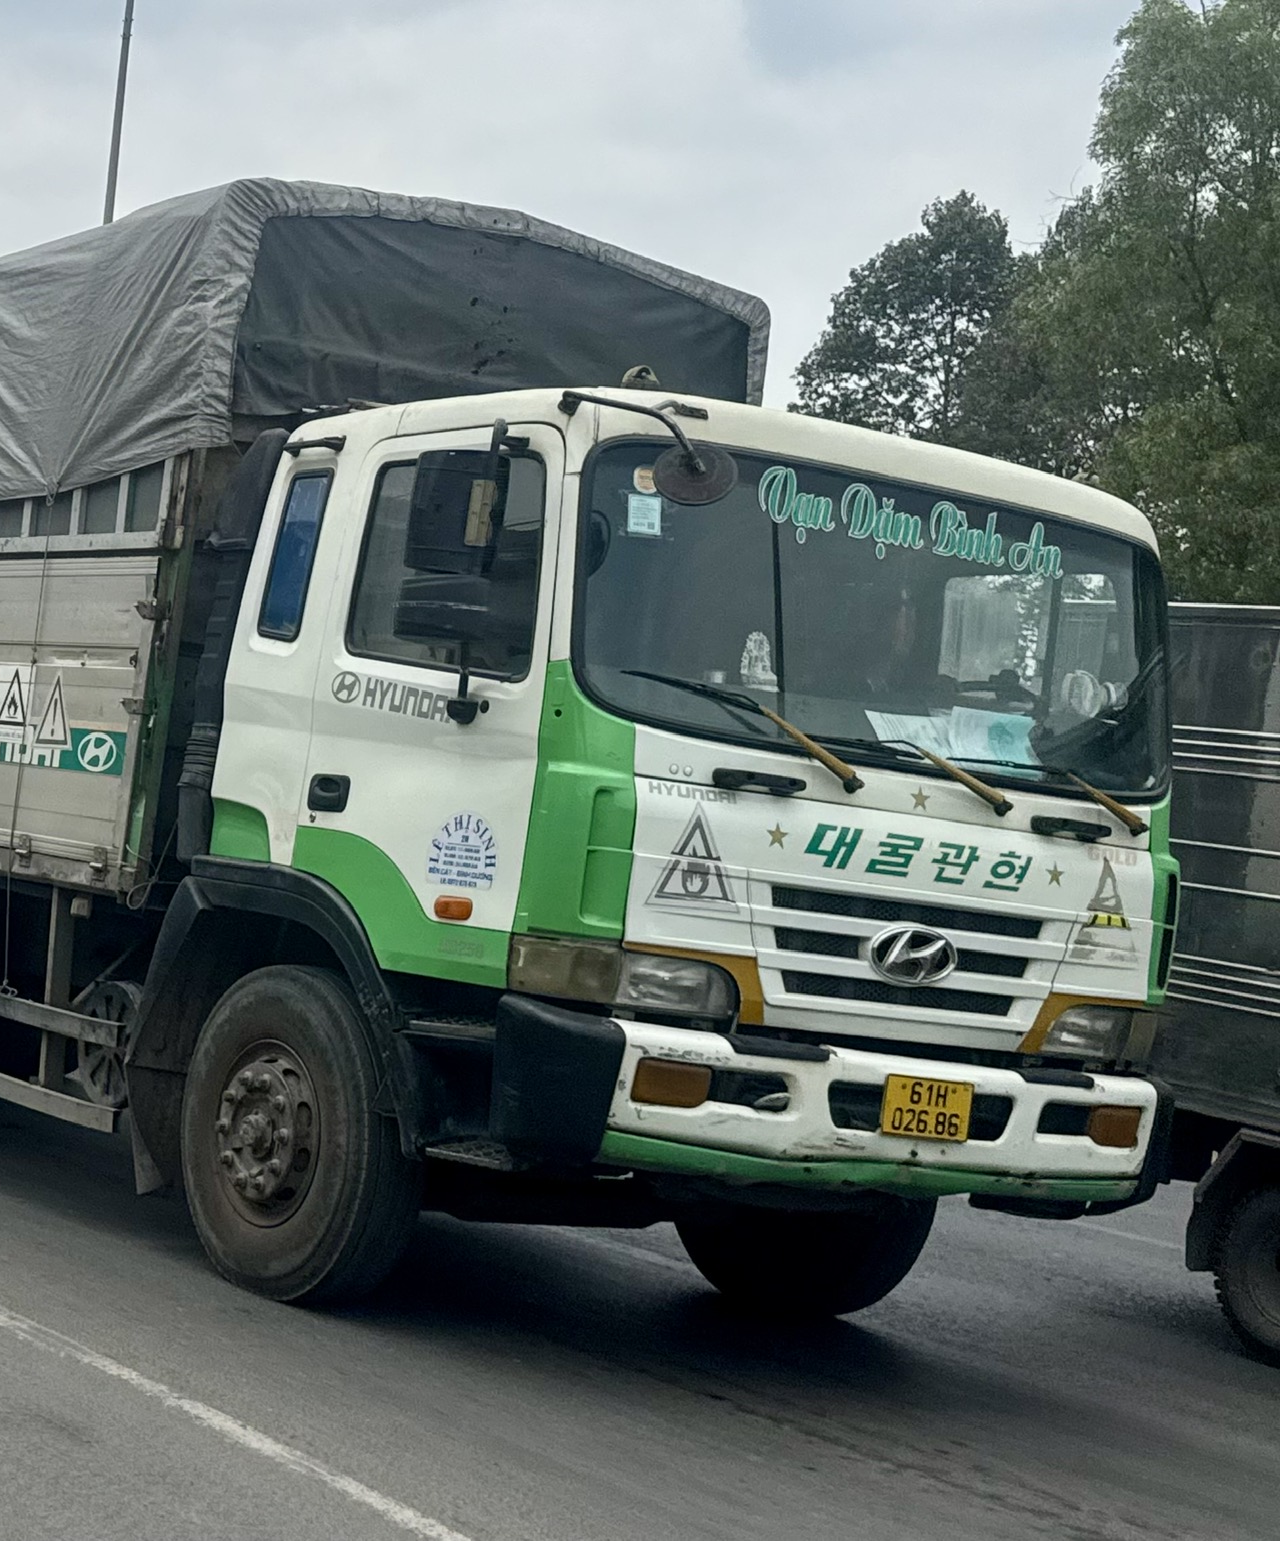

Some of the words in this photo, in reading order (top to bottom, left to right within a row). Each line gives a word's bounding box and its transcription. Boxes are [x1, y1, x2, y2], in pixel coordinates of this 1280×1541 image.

[841, 483, 924, 560] Dặm
[929, 500, 1005, 567] Bình
[1008, 521, 1064, 580] An
[362, 676, 451, 724] HYUNDA
[648, 781, 737, 805] HYUNDAI
[473, 818, 496, 869] SINH
[910, 1081, 948, 1108] 61H
[891, 1107, 960, 1137] 026.86
